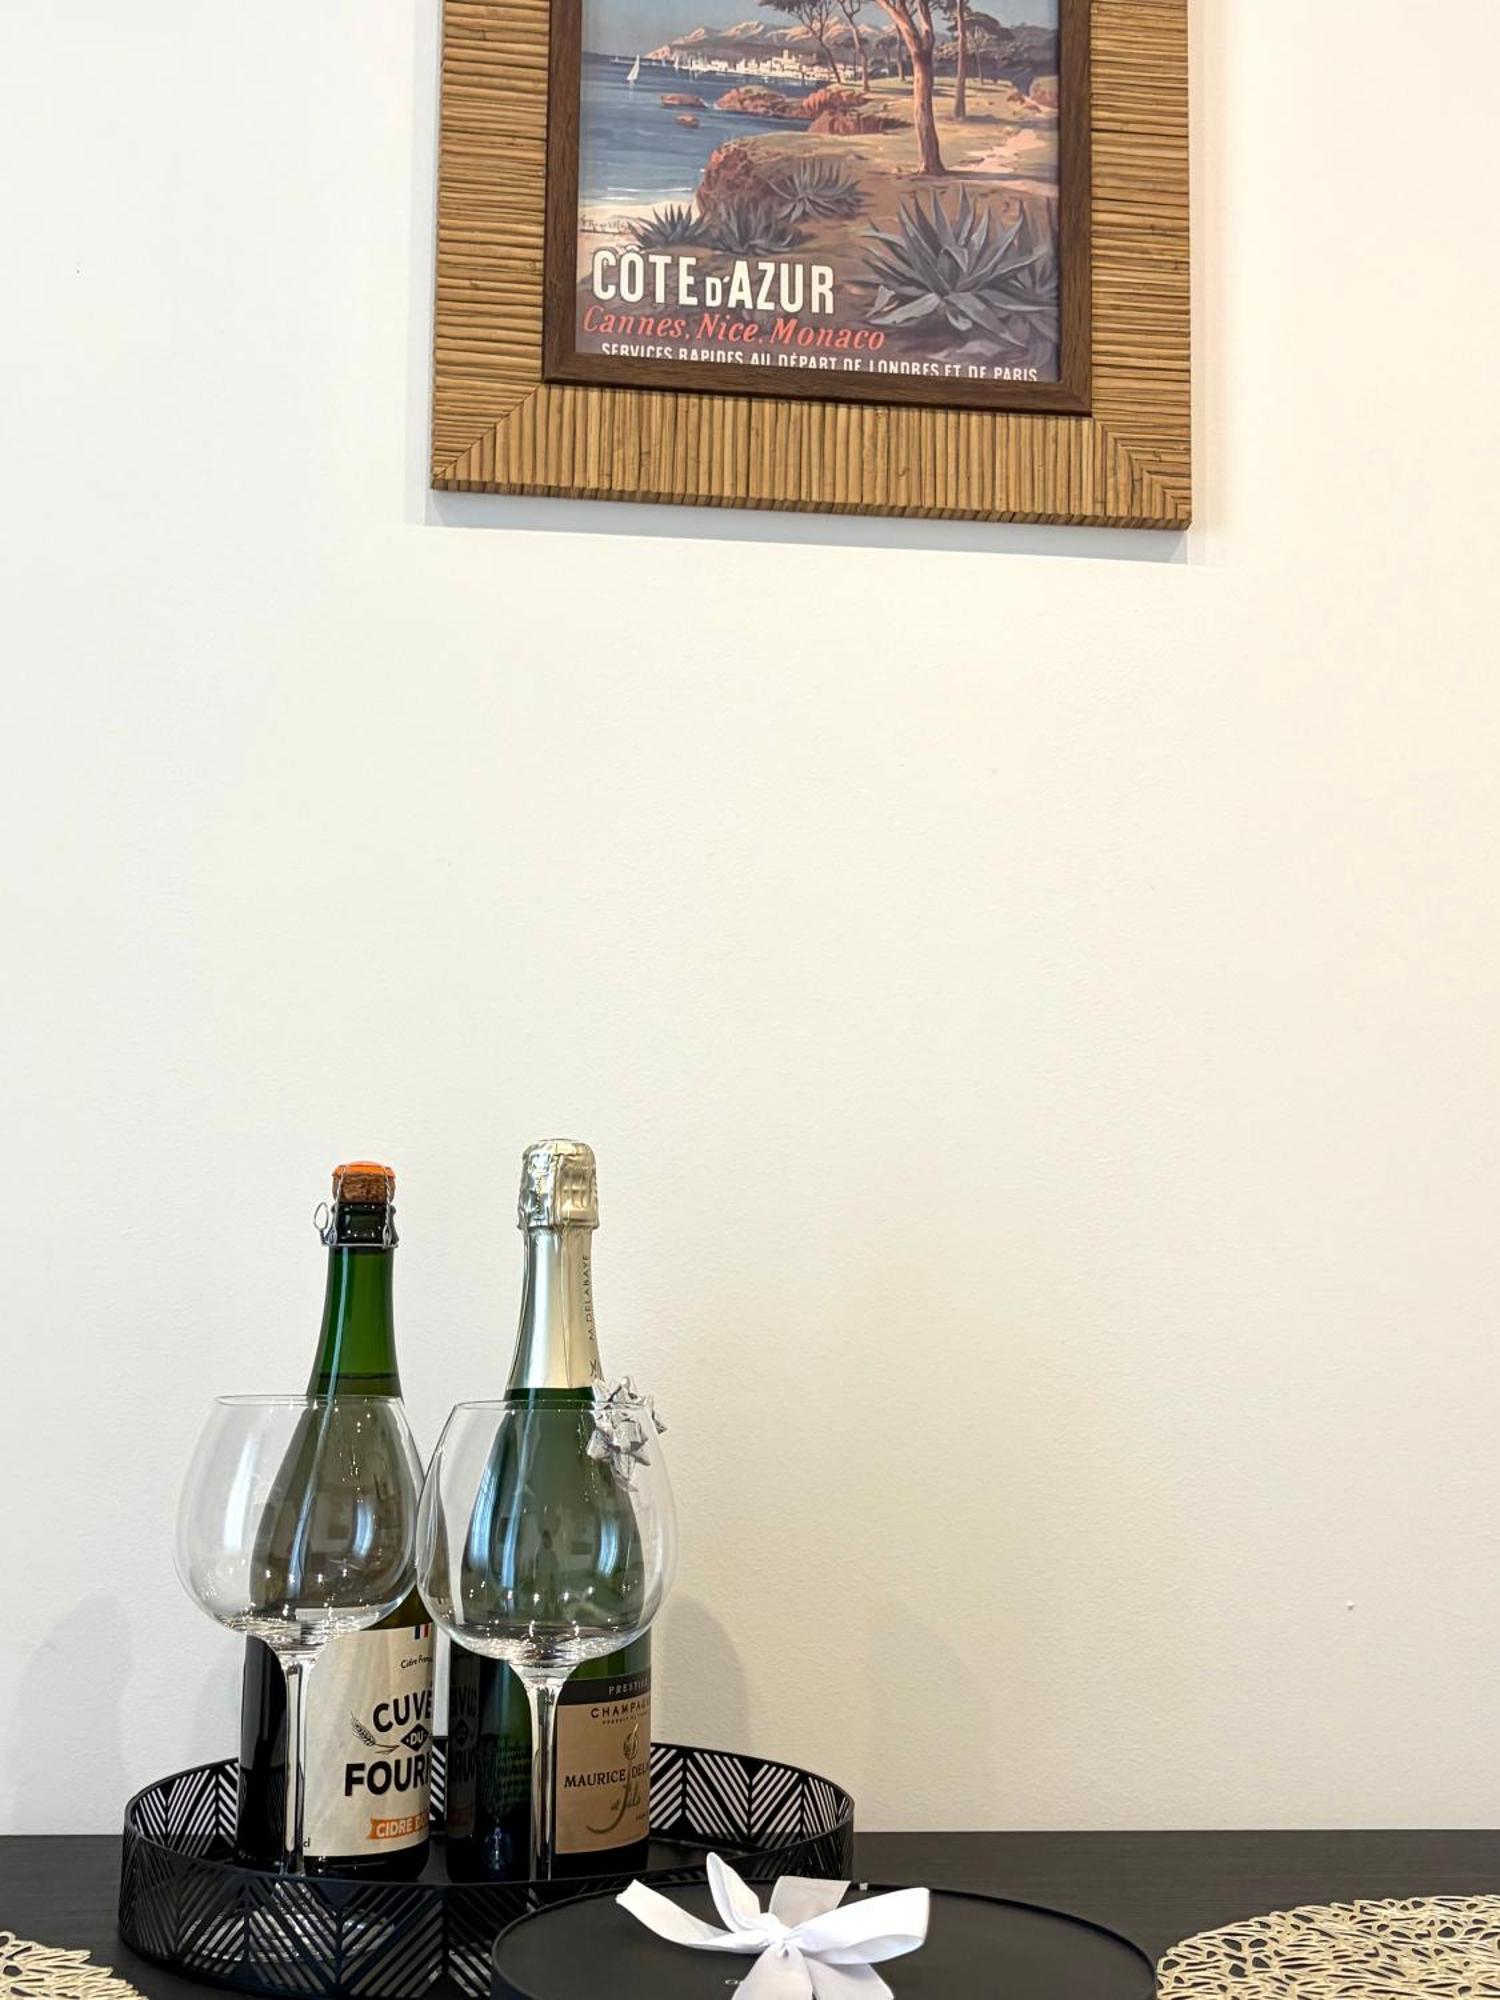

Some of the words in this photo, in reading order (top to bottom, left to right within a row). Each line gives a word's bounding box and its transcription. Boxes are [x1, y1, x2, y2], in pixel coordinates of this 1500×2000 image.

[769, 317, 886, 351] Monaco
[601, 342, 673, 360] SERVICES
[679, 348, 744, 365] RAPIDES
[994, 367, 1038, 382] PARIS
[410, 1729, 424, 1746] DU
[564, 1768, 626, 1788] MAURICE
[375, 1819, 413, 1838] CIDRE
